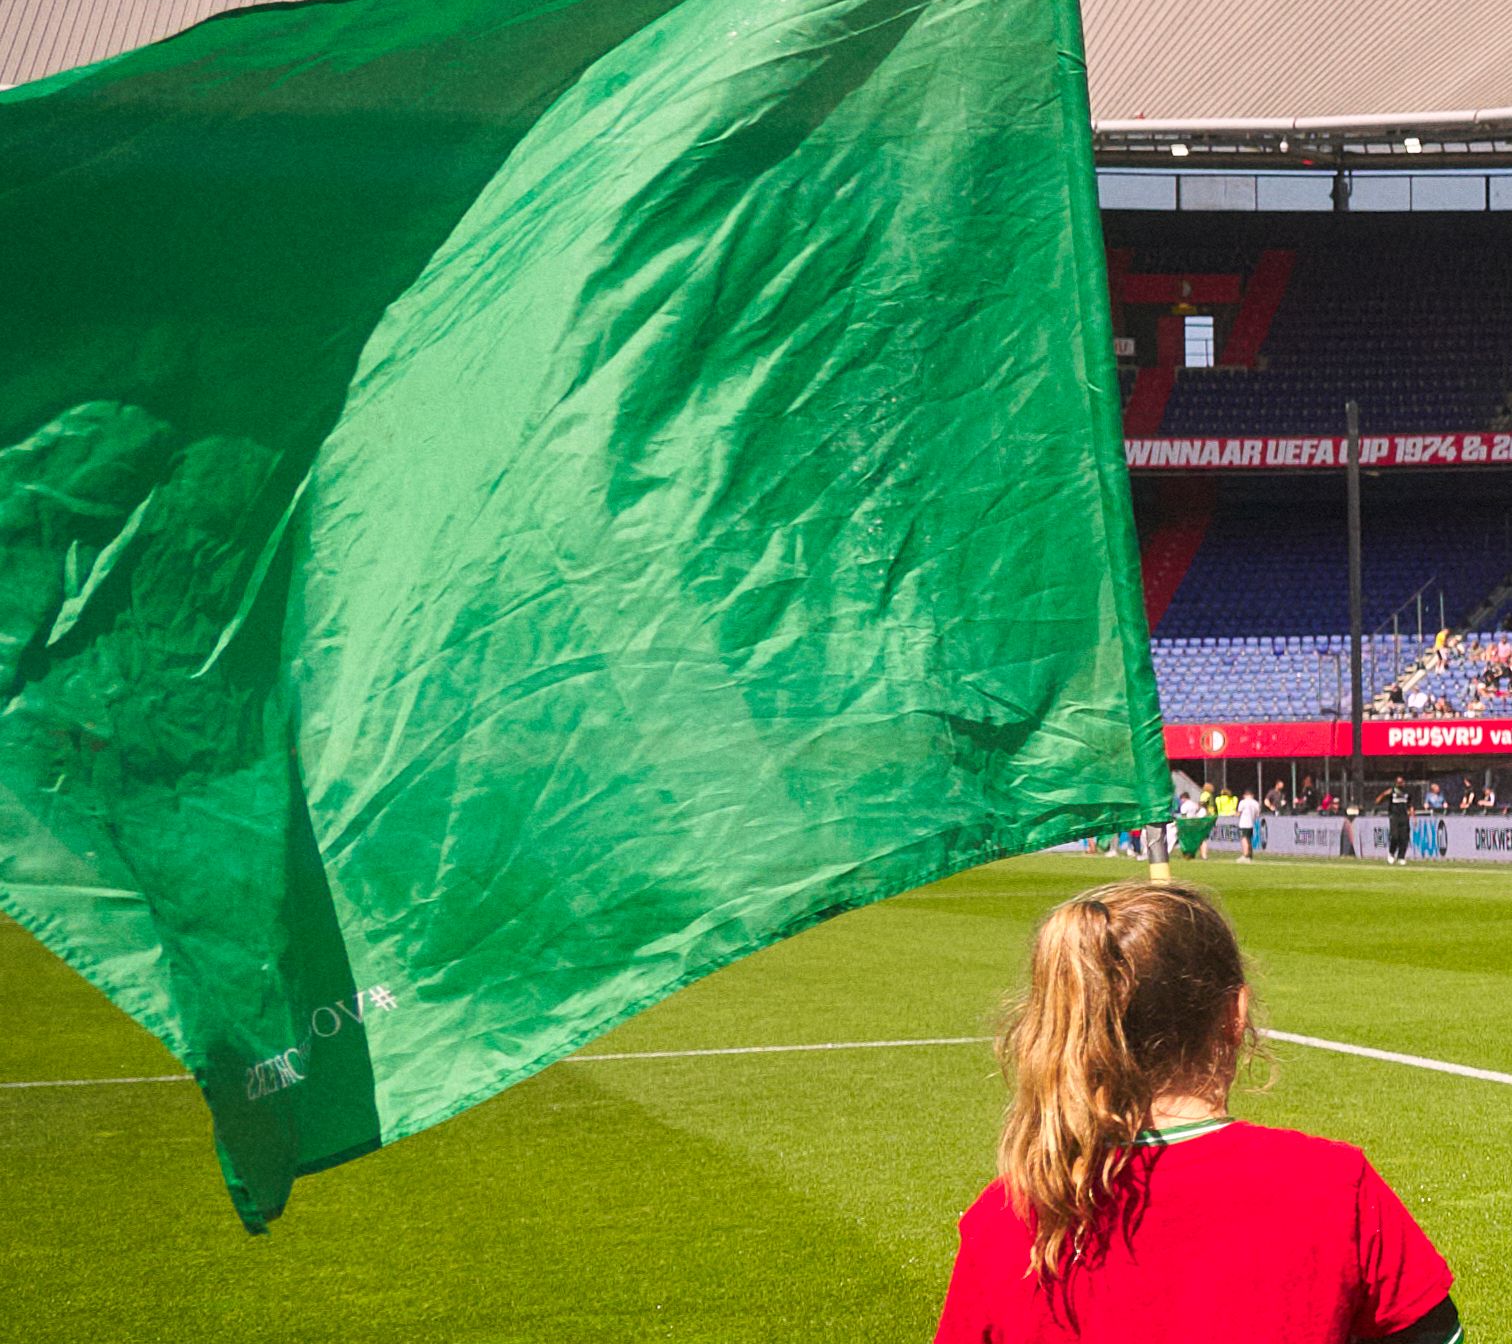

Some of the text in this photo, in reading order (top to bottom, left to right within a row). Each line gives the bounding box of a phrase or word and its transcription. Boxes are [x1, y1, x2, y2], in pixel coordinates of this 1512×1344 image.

[1124, 438, 1261, 467] WINNAAR
[1266, 439, 1334, 466] UEFA
[1394, 436, 1457, 462] 1974
[1461, 436, 1487, 461] &
